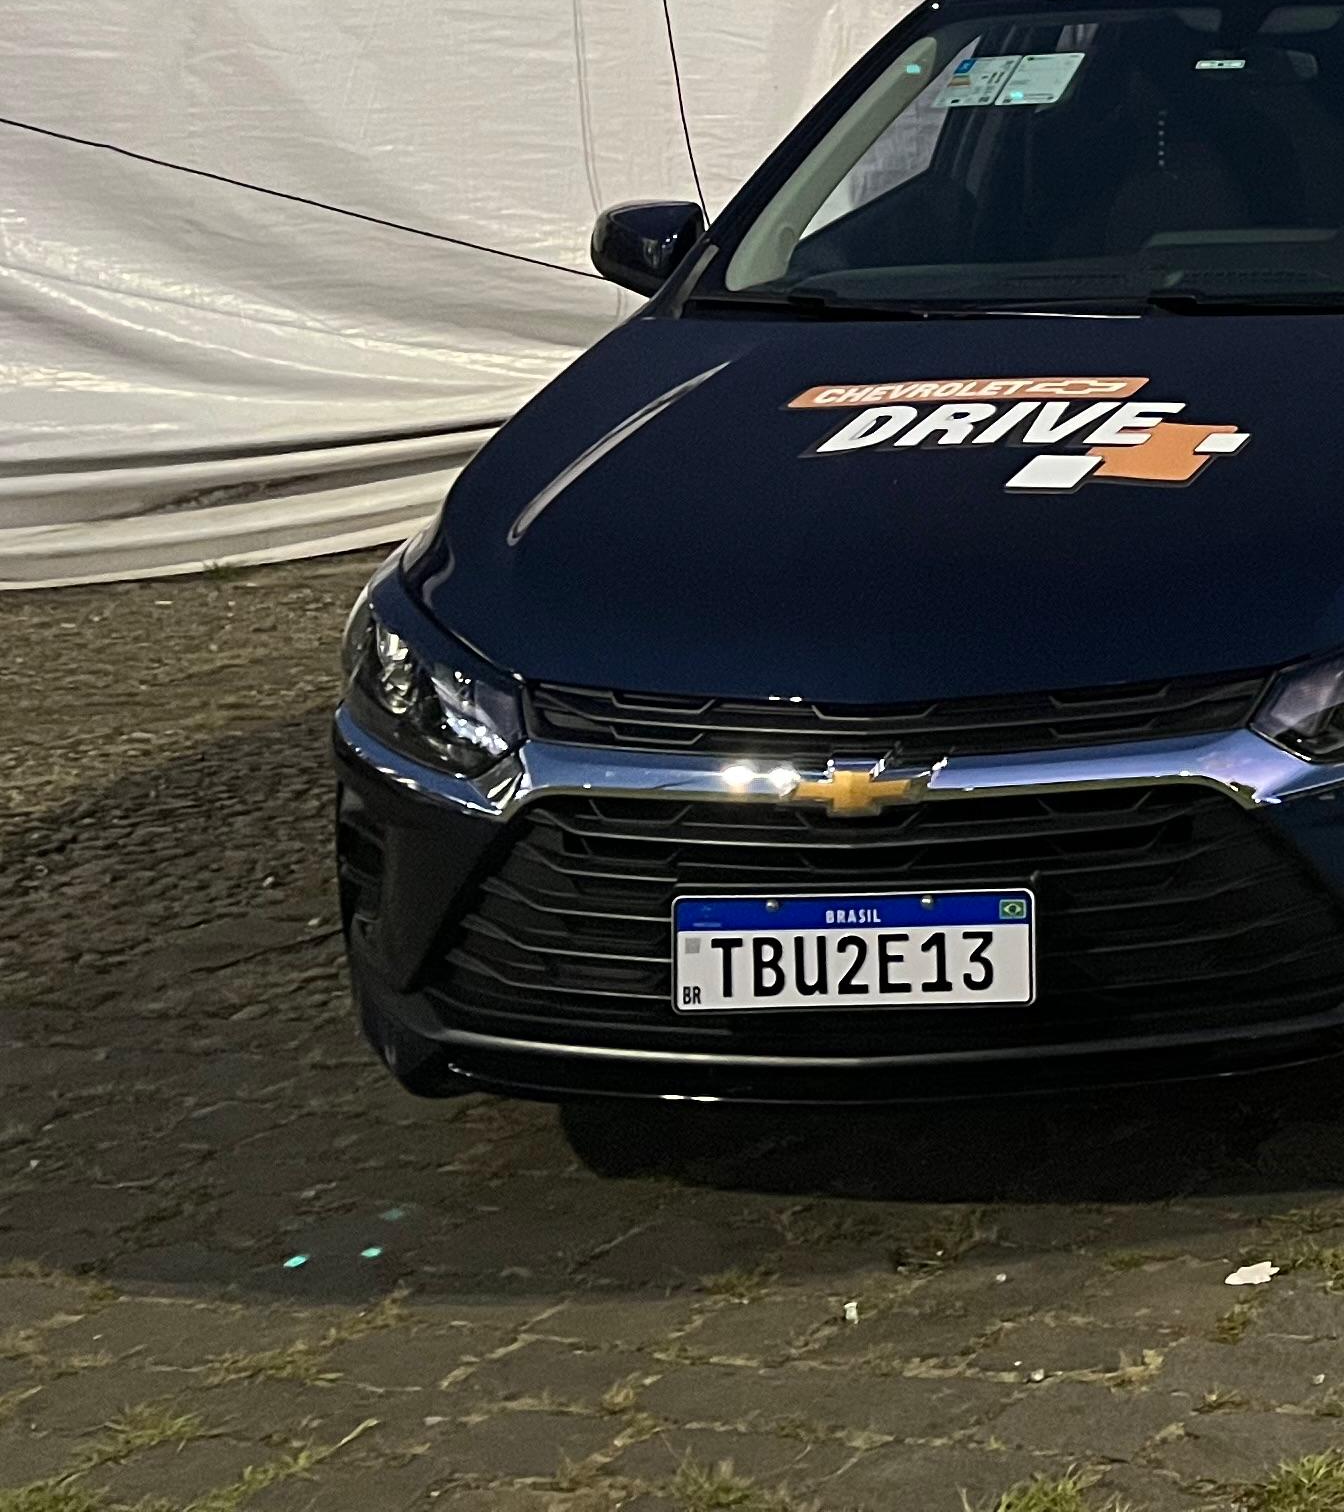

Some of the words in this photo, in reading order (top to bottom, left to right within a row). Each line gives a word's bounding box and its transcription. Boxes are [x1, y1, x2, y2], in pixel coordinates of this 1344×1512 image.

[812, 380, 1034, 405] CHEVROLET
[815, 401, 1187, 454] DRIVE
[825, 908, 881, 925] BRASIL
[710, 930, 994, 998] TBU2E13
[682, 985, 702, 1006] BR
